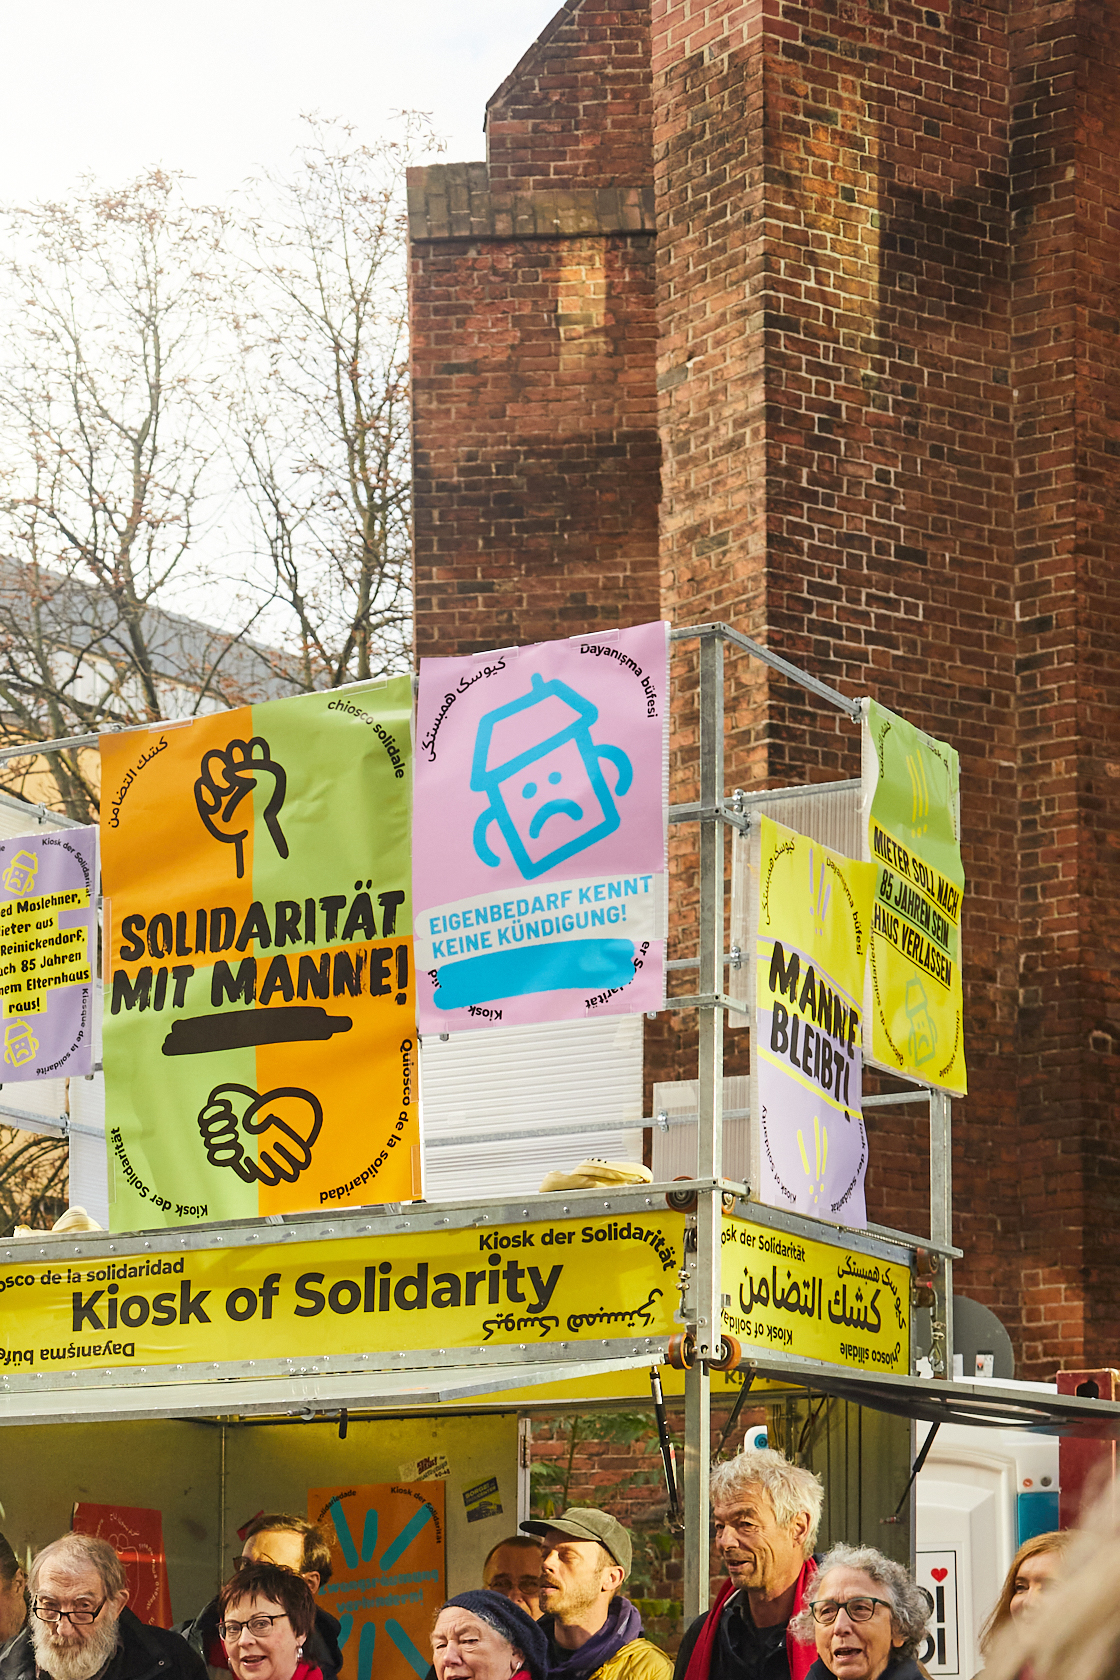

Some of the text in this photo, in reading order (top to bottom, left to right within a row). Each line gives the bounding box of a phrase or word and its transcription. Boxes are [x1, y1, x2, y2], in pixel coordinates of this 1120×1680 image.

[580, 644, 658, 718] Dayanışma büfesi
[327, 700, 404, 778] chiosco solidale
[42, 838, 62, 846] Kiosk
[62, 842, 76, 854] der
[874, 826, 959, 918] MIETER SOLL NACH
[16, 892, 81, 914] Moslehner,
[36, 917, 54, 930] aus
[120, 880, 405, 961] SOLIDARITÄT
[429, 875, 653, 935] EIGENBEDARF KENNT
[880, 869, 949, 948] 85 JAHREN SEIN
[432, 904, 627, 959] KEINE KÜNDIGUNG!
[874, 902, 952, 986] HAUS VERLASSEN
[21, 958, 36, 973] 85
[40, 952, 81, 968] Jahren
[27, 970, 90, 991] Elternhaus
[111, 945, 408, 1015] MIT MANNE!
[8, 998, 40, 1013] raus!
[468, 1004, 502, 1021] Kiosk
[769, 941, 858, 1060] MANNE
[70, 1043, 78, 1052] la
[77, 1030, 84, 1042] de
[36, 1052, 71, 1076] solidarité
[770, 1000, 850, 1122] BLEIBT!
[320, 1038, 412, 1204] Quiosco de la solidaridad
[110, 1126, 208, 1219] Kiosk der Solidarität
[480, 1222, 676, 1272] Kiosk der Solidarität
[740, 1229, 756, 1247] der
[759, 1235, 806, 1262] Solidarität
[40, 1270, 62, 1286] de
[67, 1268, 81, 1284] la
[86, 1258, 185, 1282] solidaridad
[72, 1253, 563, 1332] Kiosk of Solidarity
[739, 1265, 882, 1334] كشك التضامن
[754, 1323, 764, 1336] of
[767, 1324, 793, 1345] Kiosk
[40, 1342, 135, 1361] Dayanışma
[390, 1487, 442, 1544] Kiosk der Solidarität
[318, 1569, 439, 1595] Zwangsräumung
[336, 1588, 423, 1613] verhindern!
